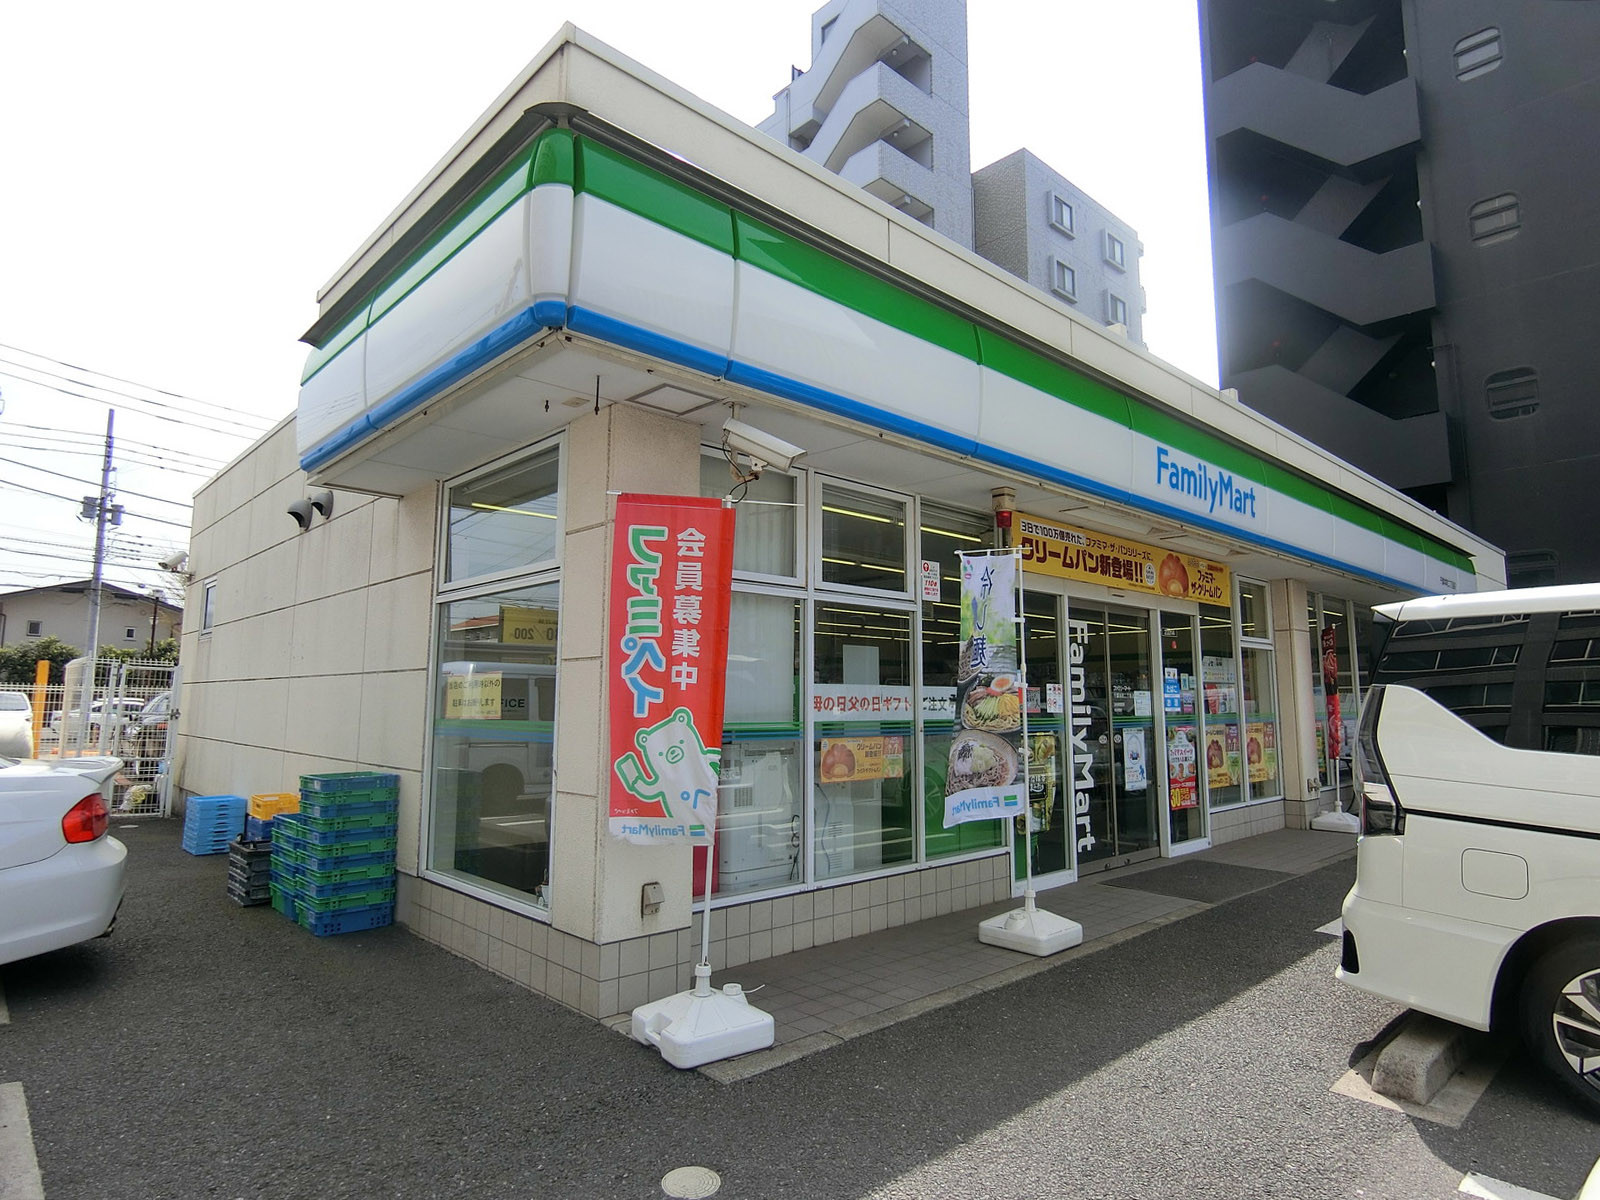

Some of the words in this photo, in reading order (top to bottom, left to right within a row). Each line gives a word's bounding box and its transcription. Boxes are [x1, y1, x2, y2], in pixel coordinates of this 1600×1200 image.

[1157, 446, 1256, 519] FamilyMart
[814, 695, 911, 712] 母の日父の日ギフト
[1069, 619, 1096, 853] FamilyMart
